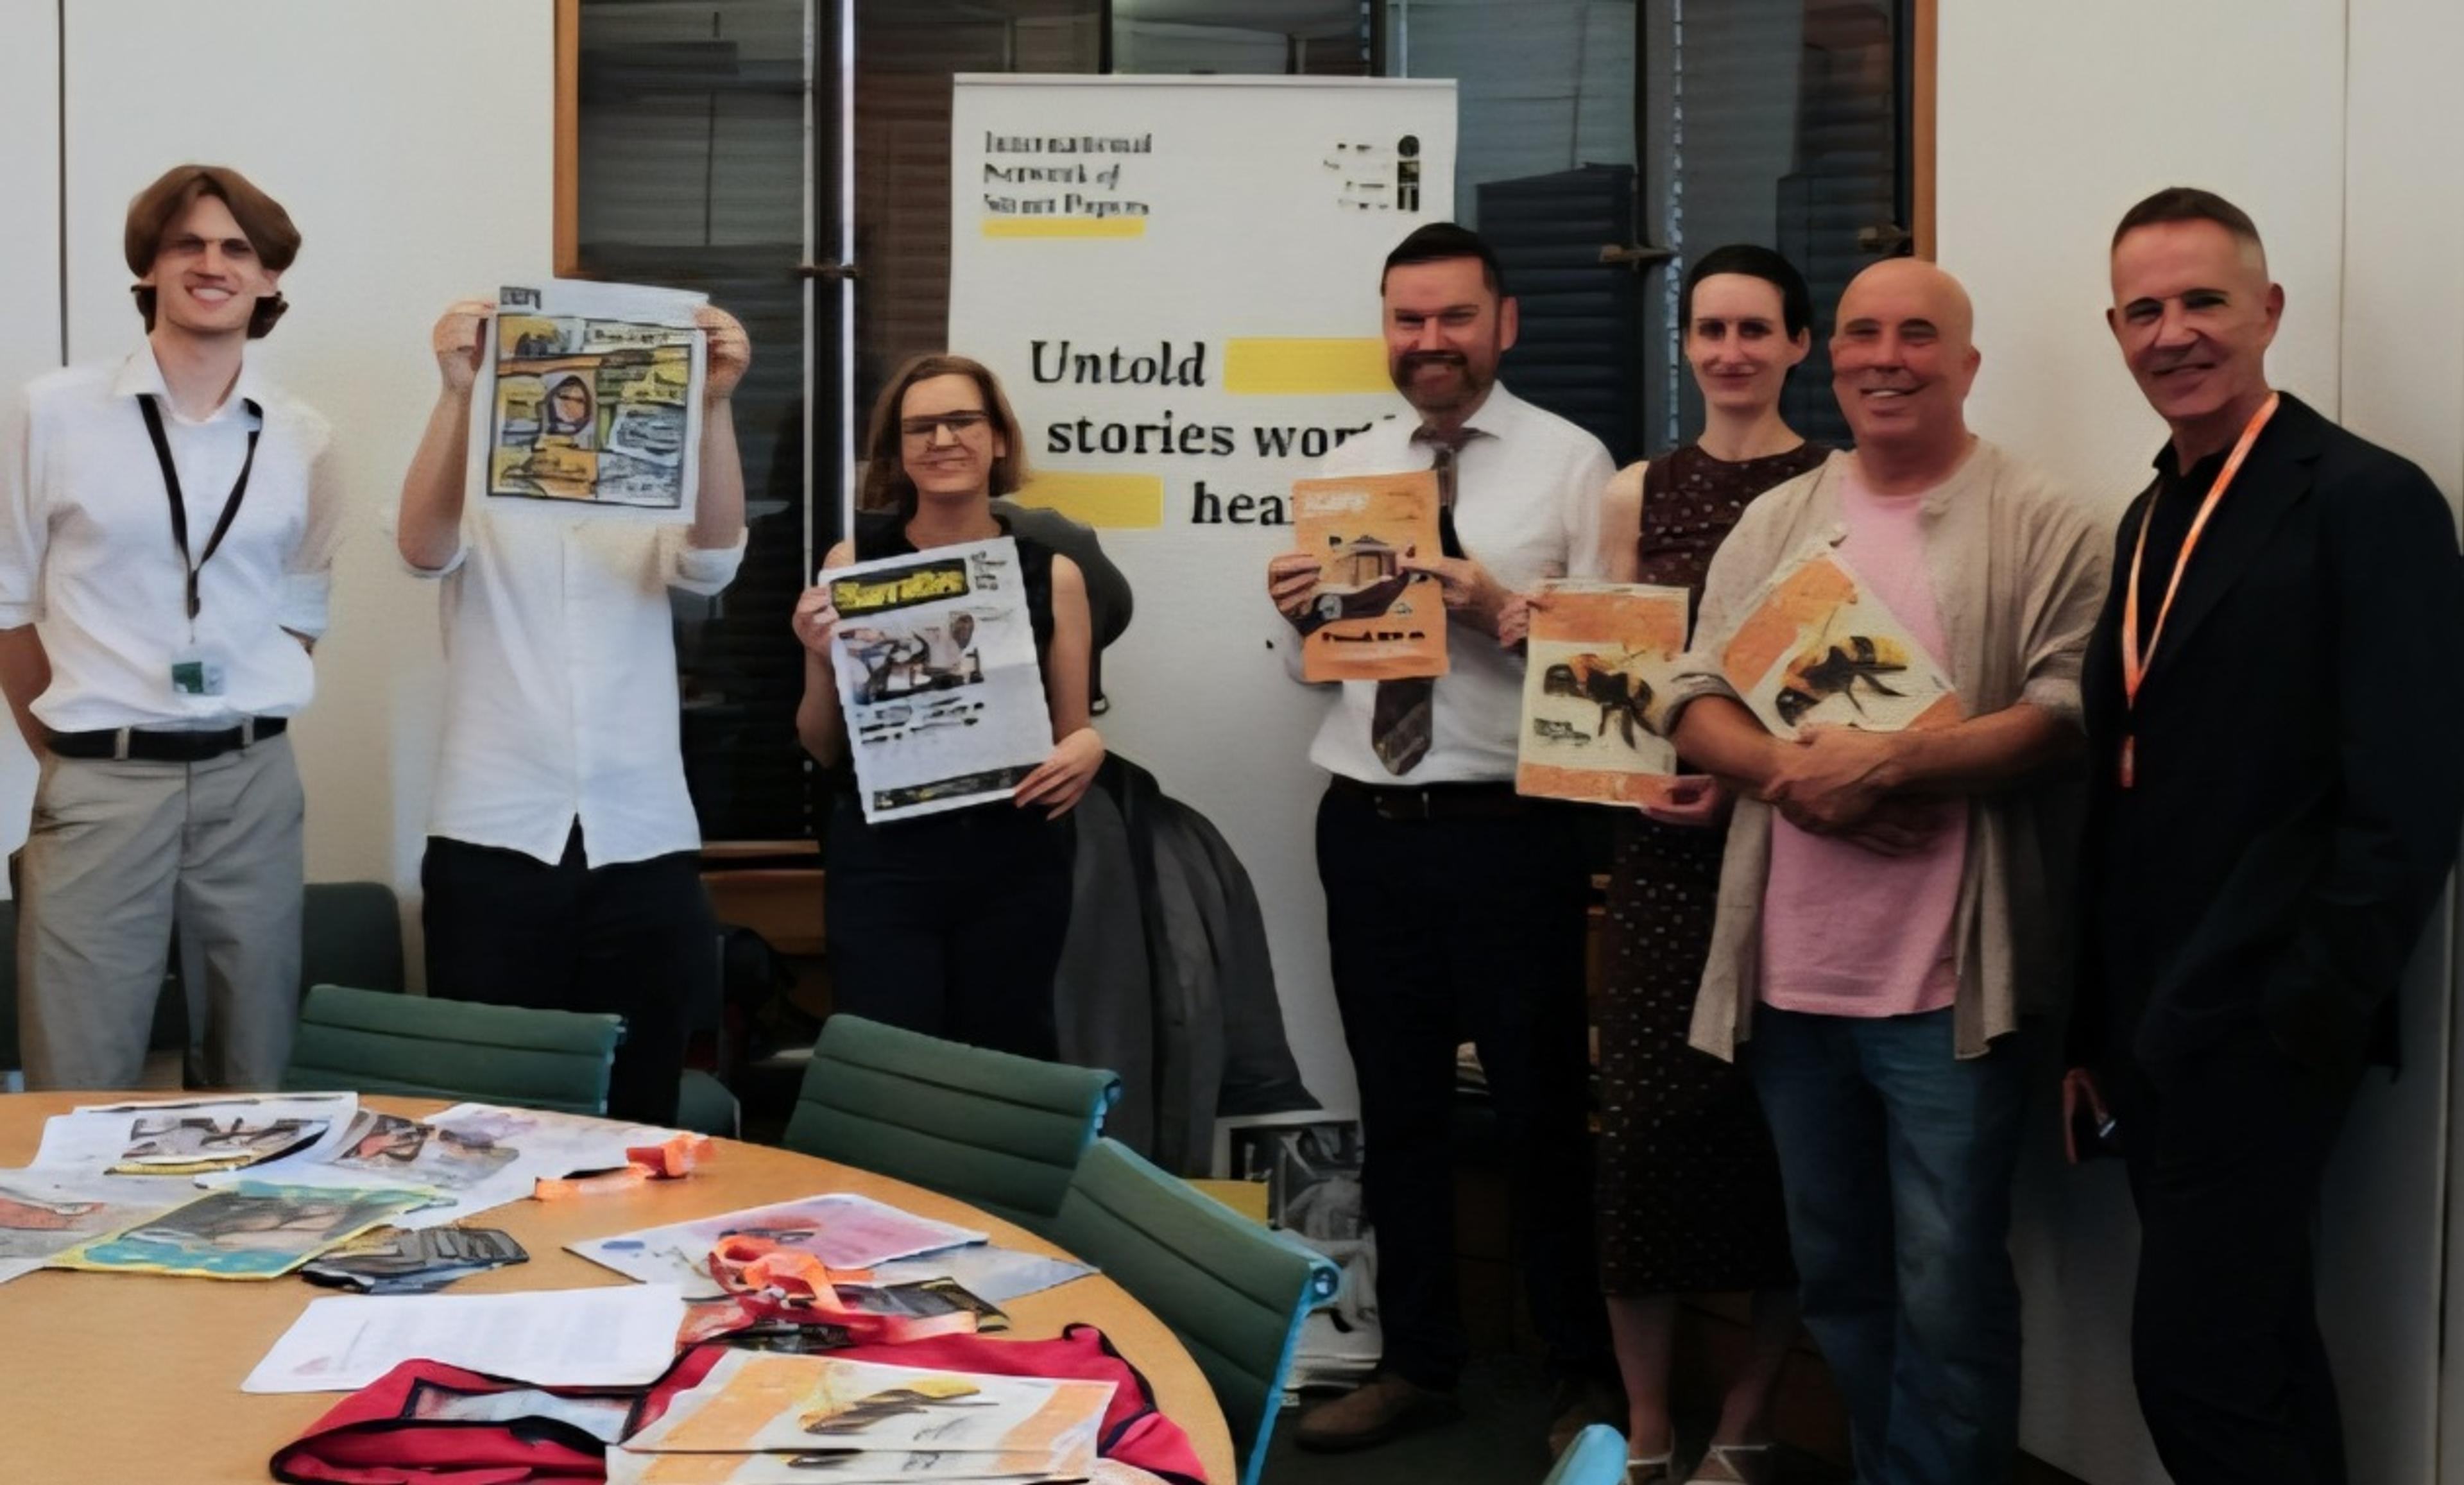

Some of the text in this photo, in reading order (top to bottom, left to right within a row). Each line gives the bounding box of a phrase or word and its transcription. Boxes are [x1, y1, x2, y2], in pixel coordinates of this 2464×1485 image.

[1031, 340, 1204, 387] Untold
[1047, 409, 1398, 458] stories wor
[1192, 481, 1295, 526] hea
